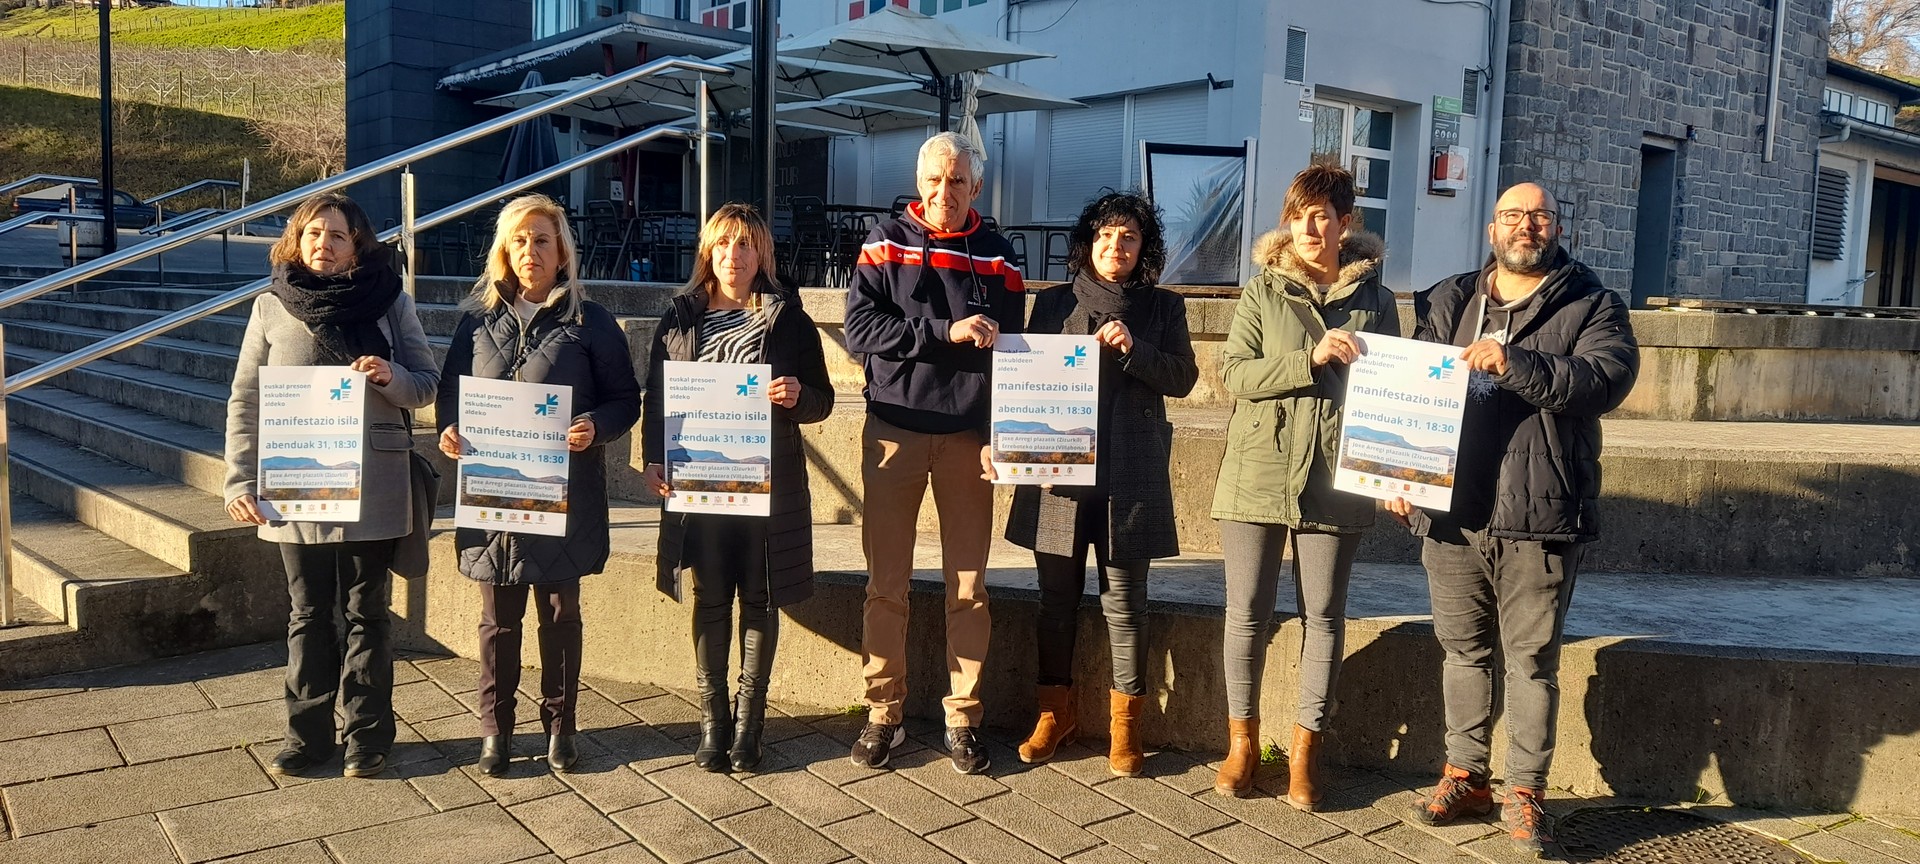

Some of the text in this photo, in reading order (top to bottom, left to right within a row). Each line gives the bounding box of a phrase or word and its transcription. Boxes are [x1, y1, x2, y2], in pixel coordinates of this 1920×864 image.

[998, 381, 1094, 392] manifestazio isila
[1353, 385, 1459, 409] manifestazio isila
[465, 401, 502, 409] eskubideen
[998, 405, 1092, 415] abenduak 31, 18:30
[264, 416, 359, 426] manifestazio isila
[670, 410, 767, 421] manifestazio isila
[1352, 409, 1454, 434] abenduak 31, 18:30
[466, 425, 566, 442] manifestazio isila
[672, 433, 766, 444] abenduak 31, 18:30
[266, 440, 357, 450] abenduak 31, 18:30
[467, 449, 564, 464] abenduak 31, 18:30
